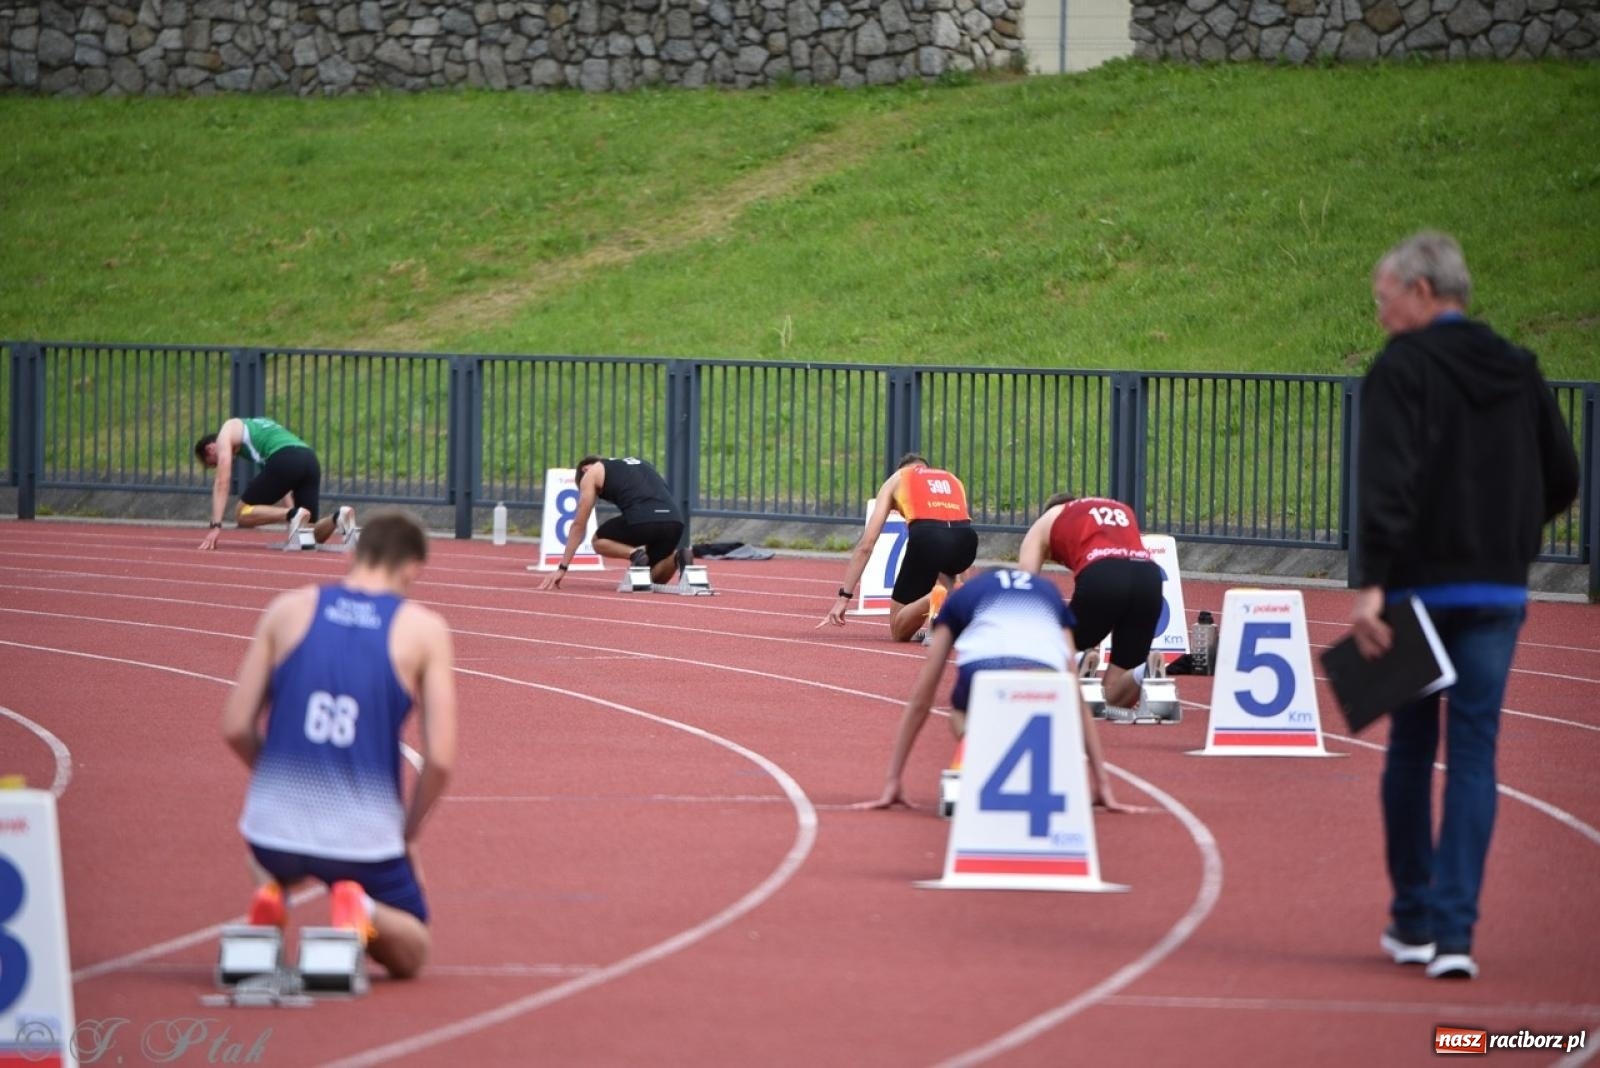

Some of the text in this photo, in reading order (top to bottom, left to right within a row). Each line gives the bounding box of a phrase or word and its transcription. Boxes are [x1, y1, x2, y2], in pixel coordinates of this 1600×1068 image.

[1088, 506, 1130, 528] 128
[880, 521, 909, 588] 7
[994, 569, 1033, 590] 12
[1164, 634, 1183, 644] Km
[1234, 621, 1296, 718] 5
[304, 689, 360, 749] 68
[1289, 711, 1313, 723] Km
[979, 713, 1067, 838] 4
